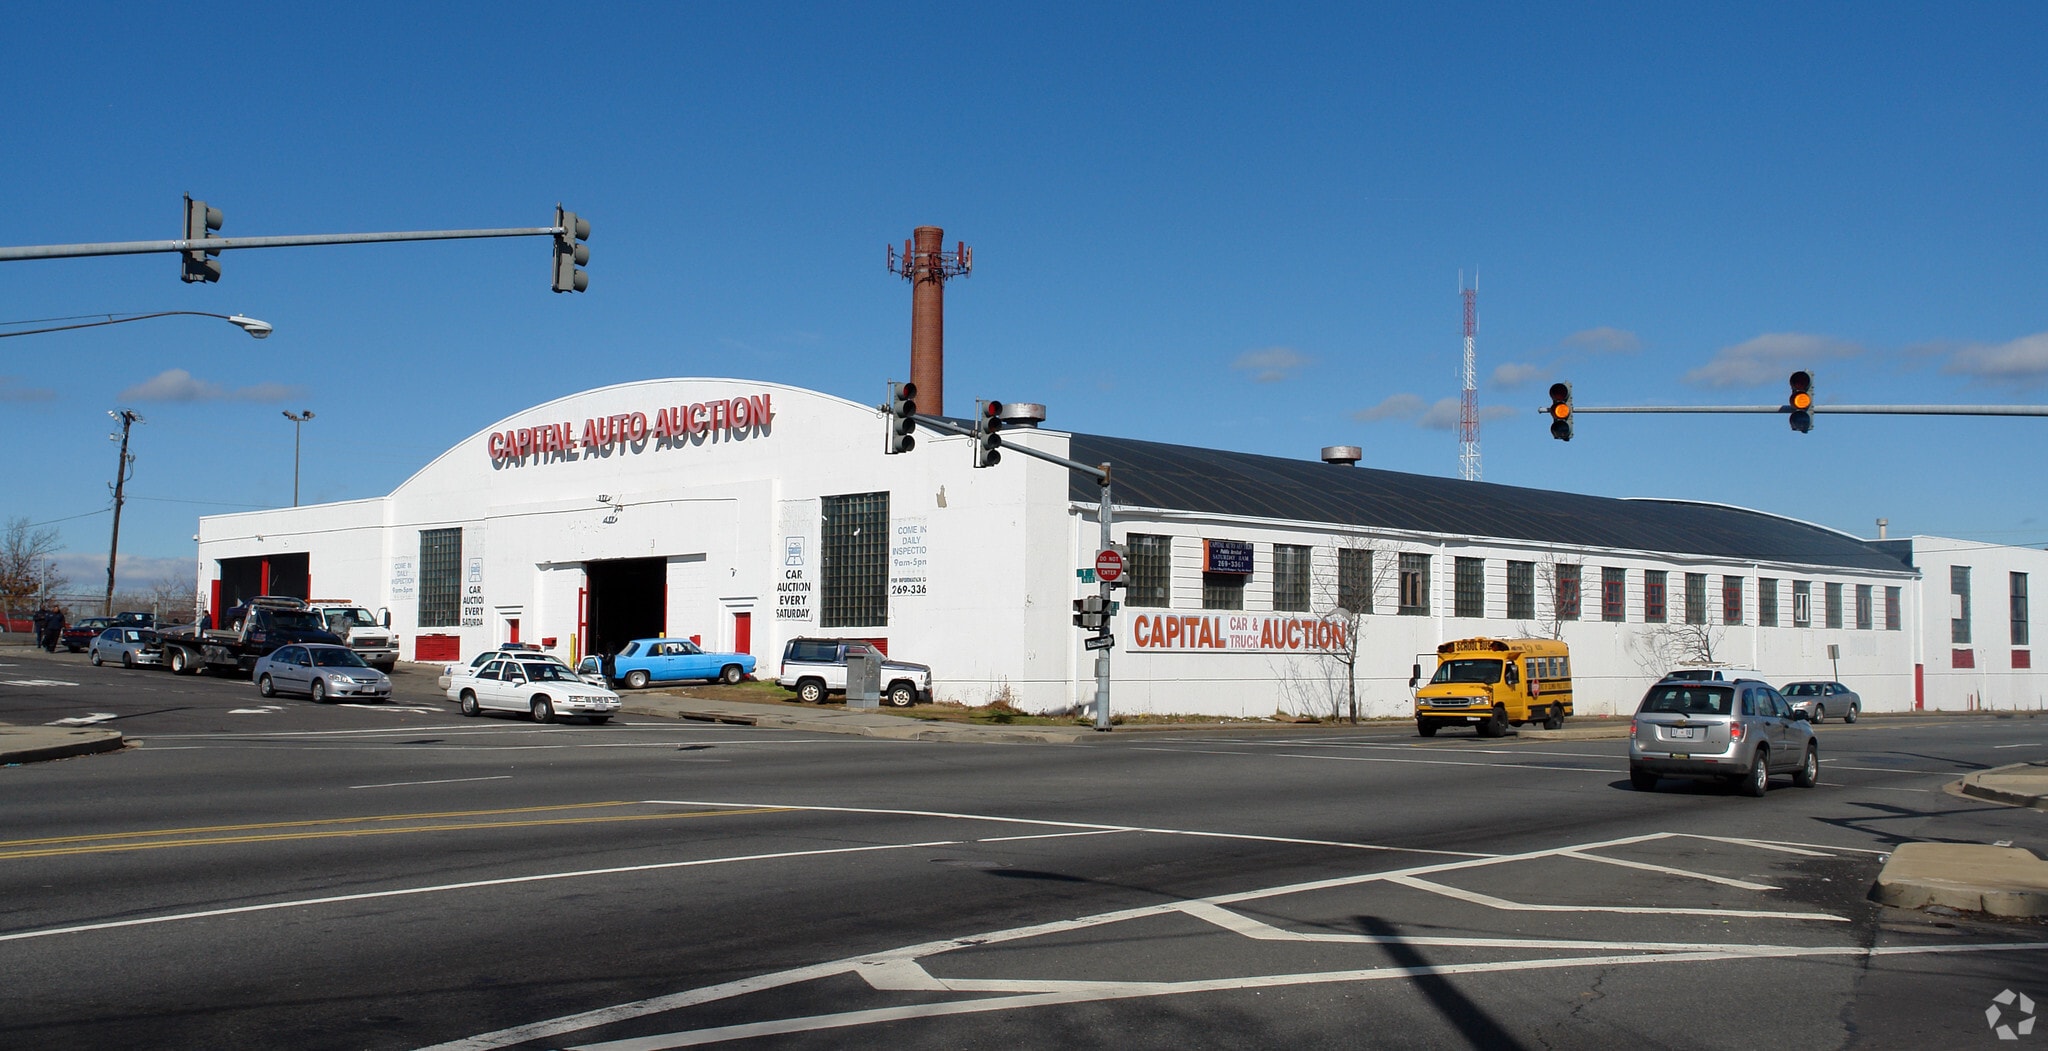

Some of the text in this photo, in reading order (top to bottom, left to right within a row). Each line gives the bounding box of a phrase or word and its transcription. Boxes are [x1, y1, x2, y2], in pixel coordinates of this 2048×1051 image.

[488, 394, 770, 459] CAPITAL AUTO AUCTION
[898, 526, 917, 534] COME
[902, 536, 921, 545] DAILY
[1218, 560, 1244, 568] 269-3361
[785, 570, 802, 579] CAR
[468, 586, 481, 594] CAR
[777, 582, 811, 592] AUCTION
[892, 585, 927, 594] 269-336
[779, 595, 807, 605] EVERY
[465, 607, 484, 615] EVERY
[776, 608, 810, 618] SATURDAY
[1230, 616, 1259, 631] CAR &
[1134, 614, 1227, 648] CAPITAL
[1260, 618, 1346, 649] AUCTION
[1230, 635, 1259, 648] TRUCK
[1457, 640, 1492, 651] SCHOOL BUS
